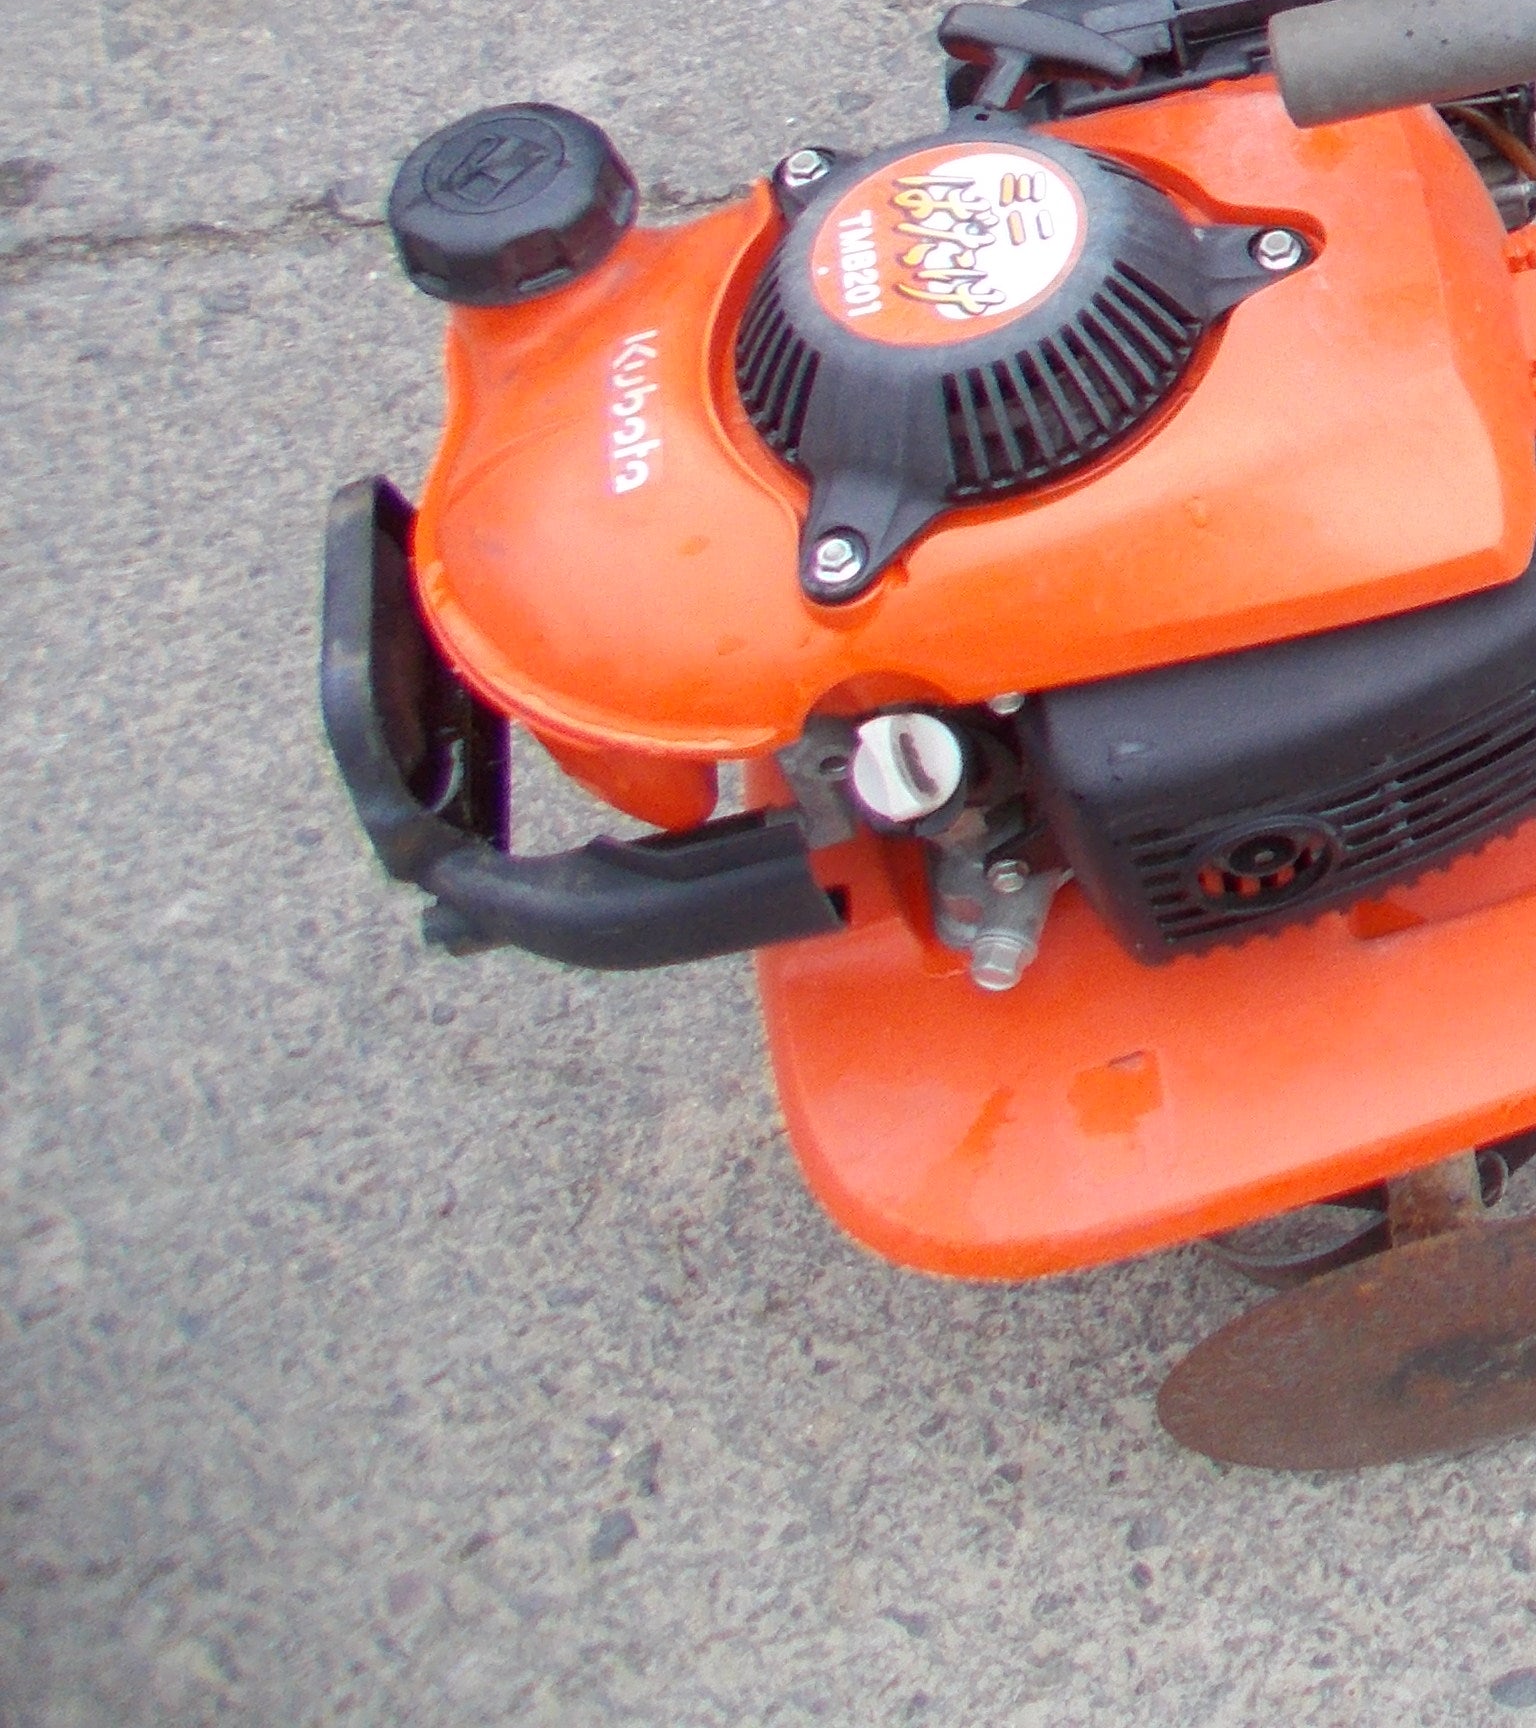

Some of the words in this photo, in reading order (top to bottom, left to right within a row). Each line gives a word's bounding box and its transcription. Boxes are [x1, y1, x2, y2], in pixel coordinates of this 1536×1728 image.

[838, 209, 883, 318] TMB201
[890, 174, 1006, 317] ばたけ
[998, 170, 1056, 248] ミニ
[611, 328, 663, 495] Kubota
